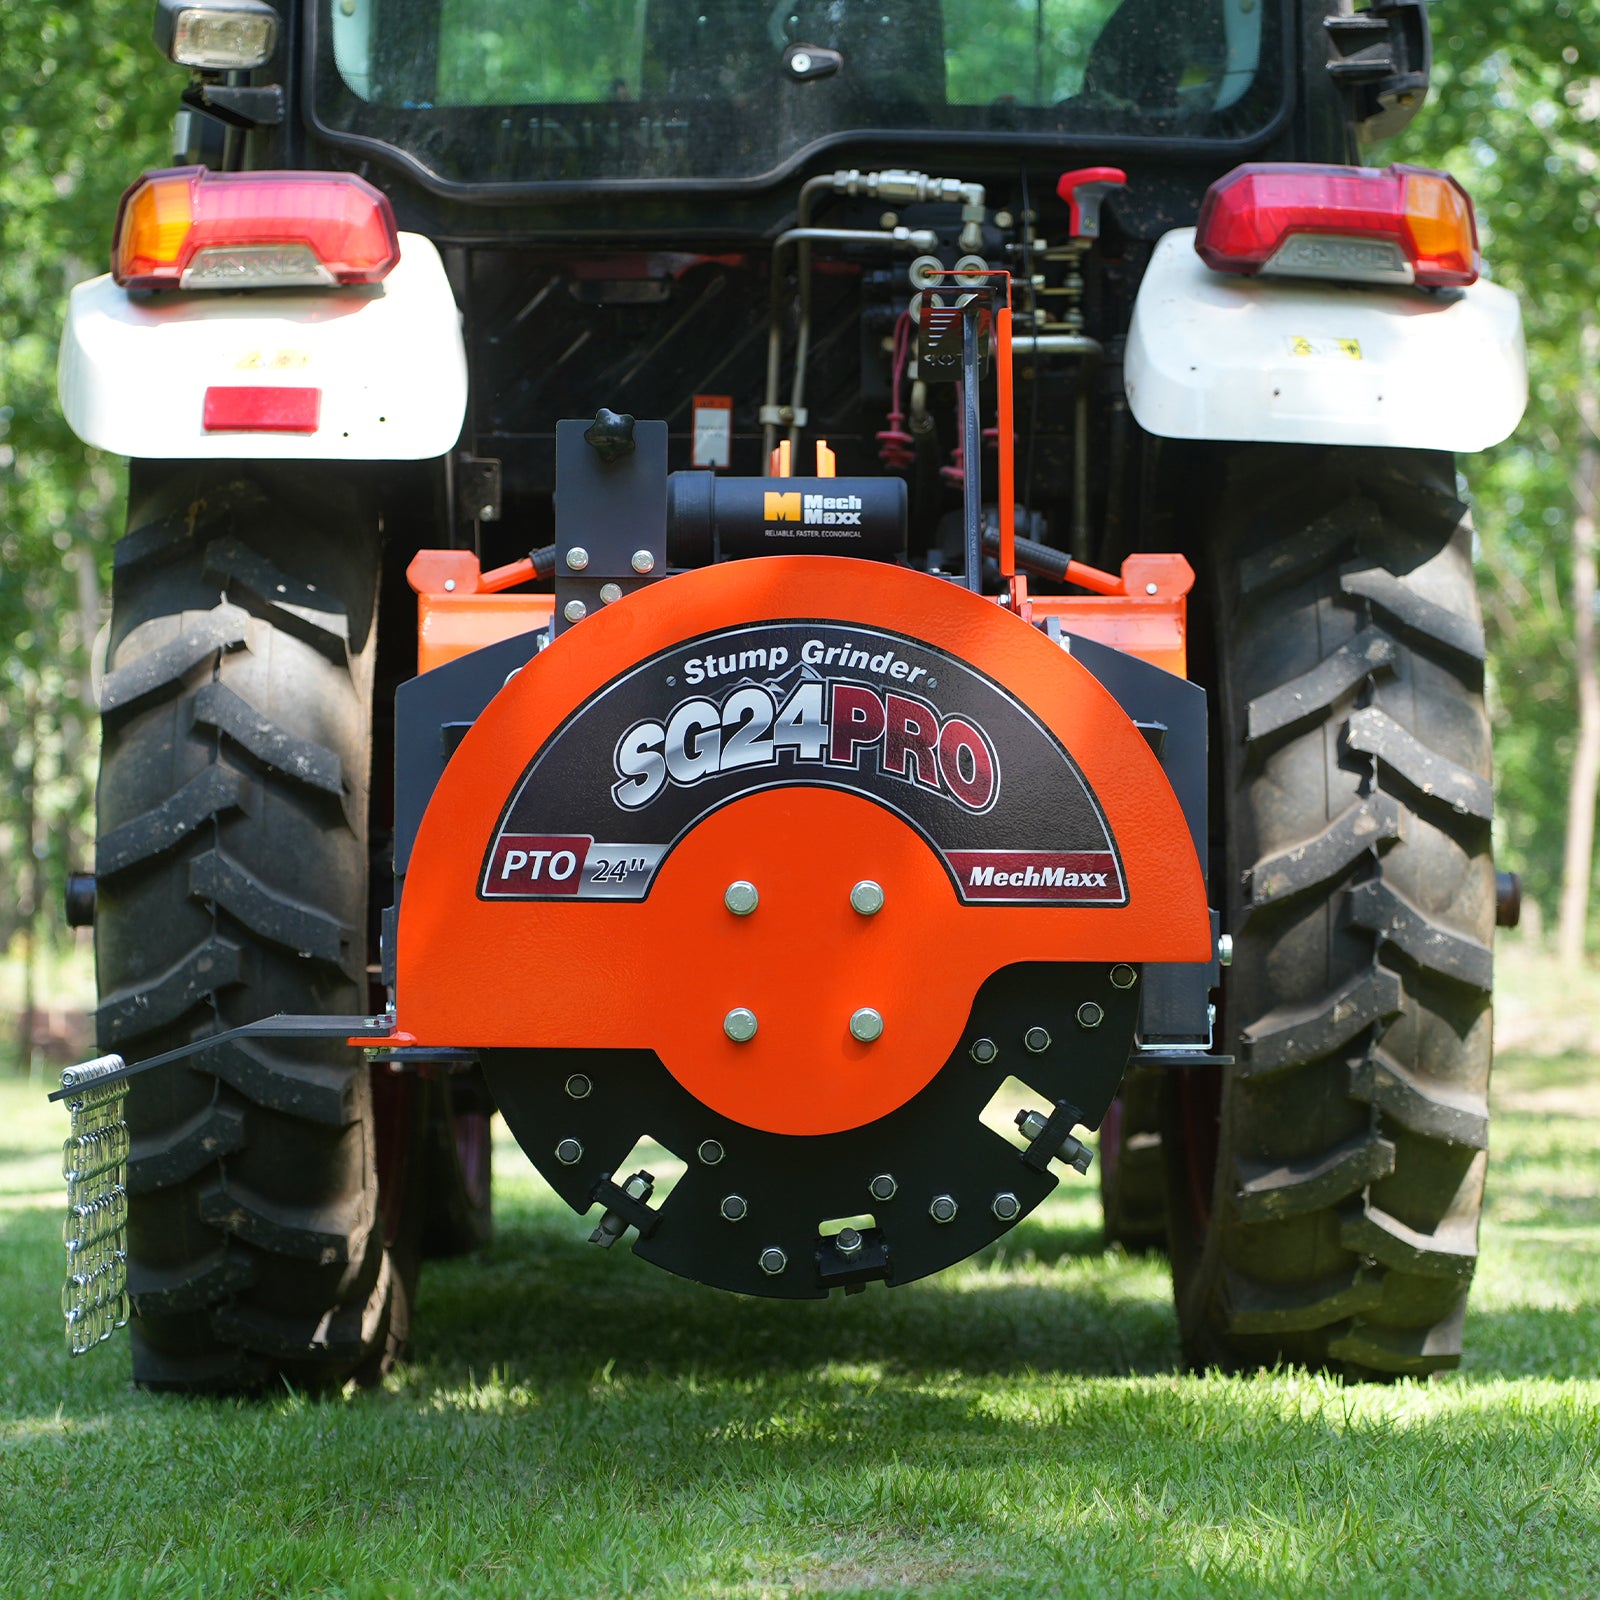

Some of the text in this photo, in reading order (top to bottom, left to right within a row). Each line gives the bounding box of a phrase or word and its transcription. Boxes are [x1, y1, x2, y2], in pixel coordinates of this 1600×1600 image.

[804, 494, 862, 509] Mech
[804, 508, 862, 525] Maxx
[684, 639, 927, 685] Stump Grinder
[614, 681, 998, 813] SG24PRO
[501, 850, 577, 881] PTO
[969, 866, 1108, 887] MechMaxx
